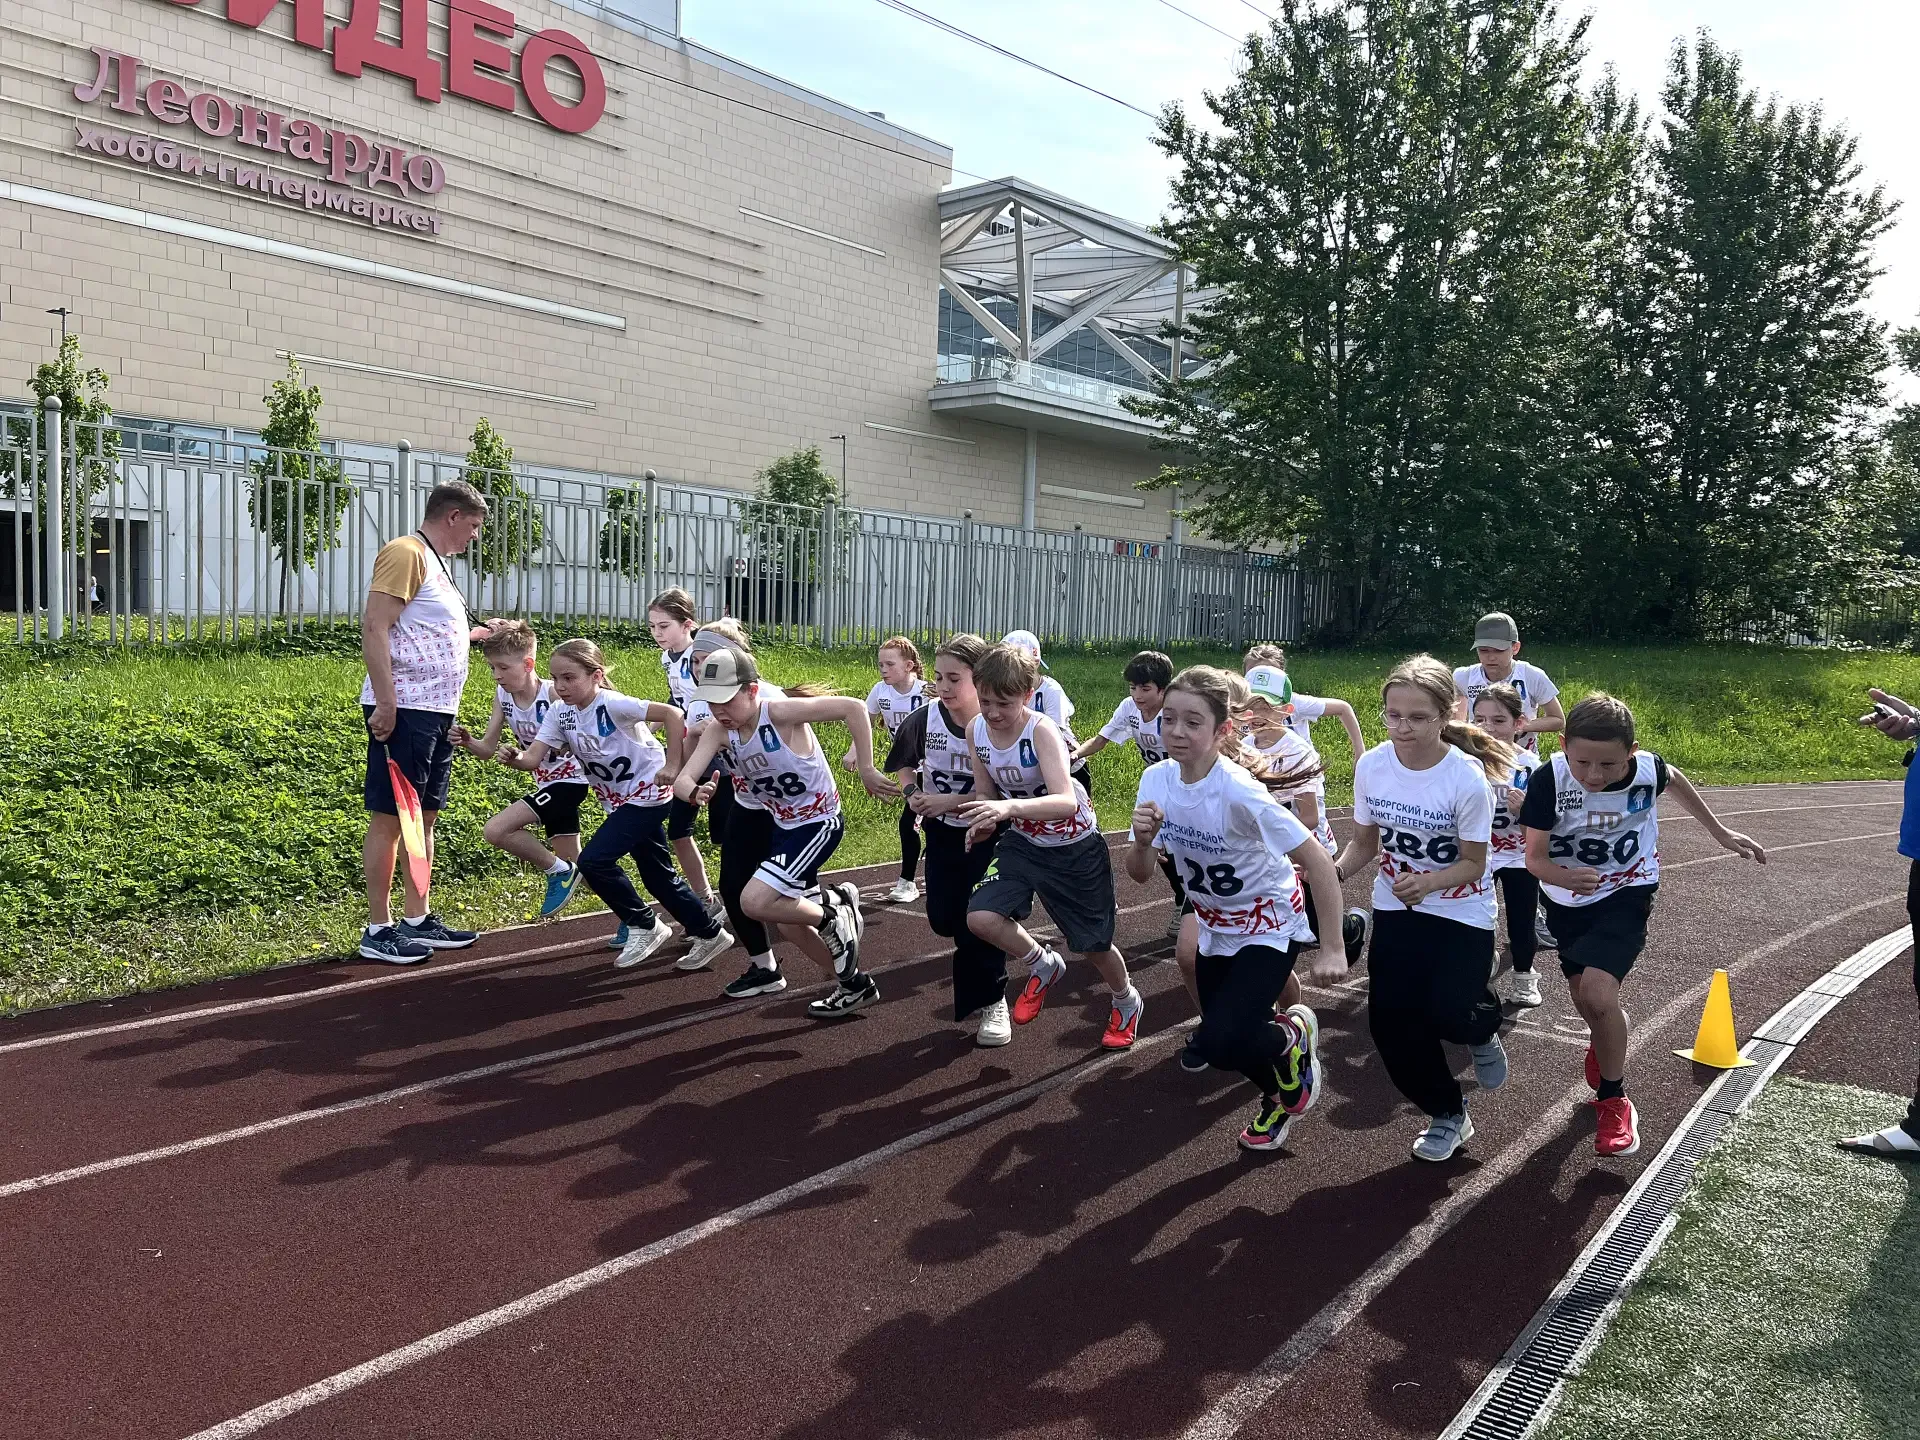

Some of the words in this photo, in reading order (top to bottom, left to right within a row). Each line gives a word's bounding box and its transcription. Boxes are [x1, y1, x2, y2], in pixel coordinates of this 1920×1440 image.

[73, 46, 446, 195] Леонардо
[75, 125, 442, 236] хобби-гипермаркет
[1369, 809, 1456, 831] АНКТ-ПЕТЕРБУРГА
[1548, 829, 1640, 866] 380
